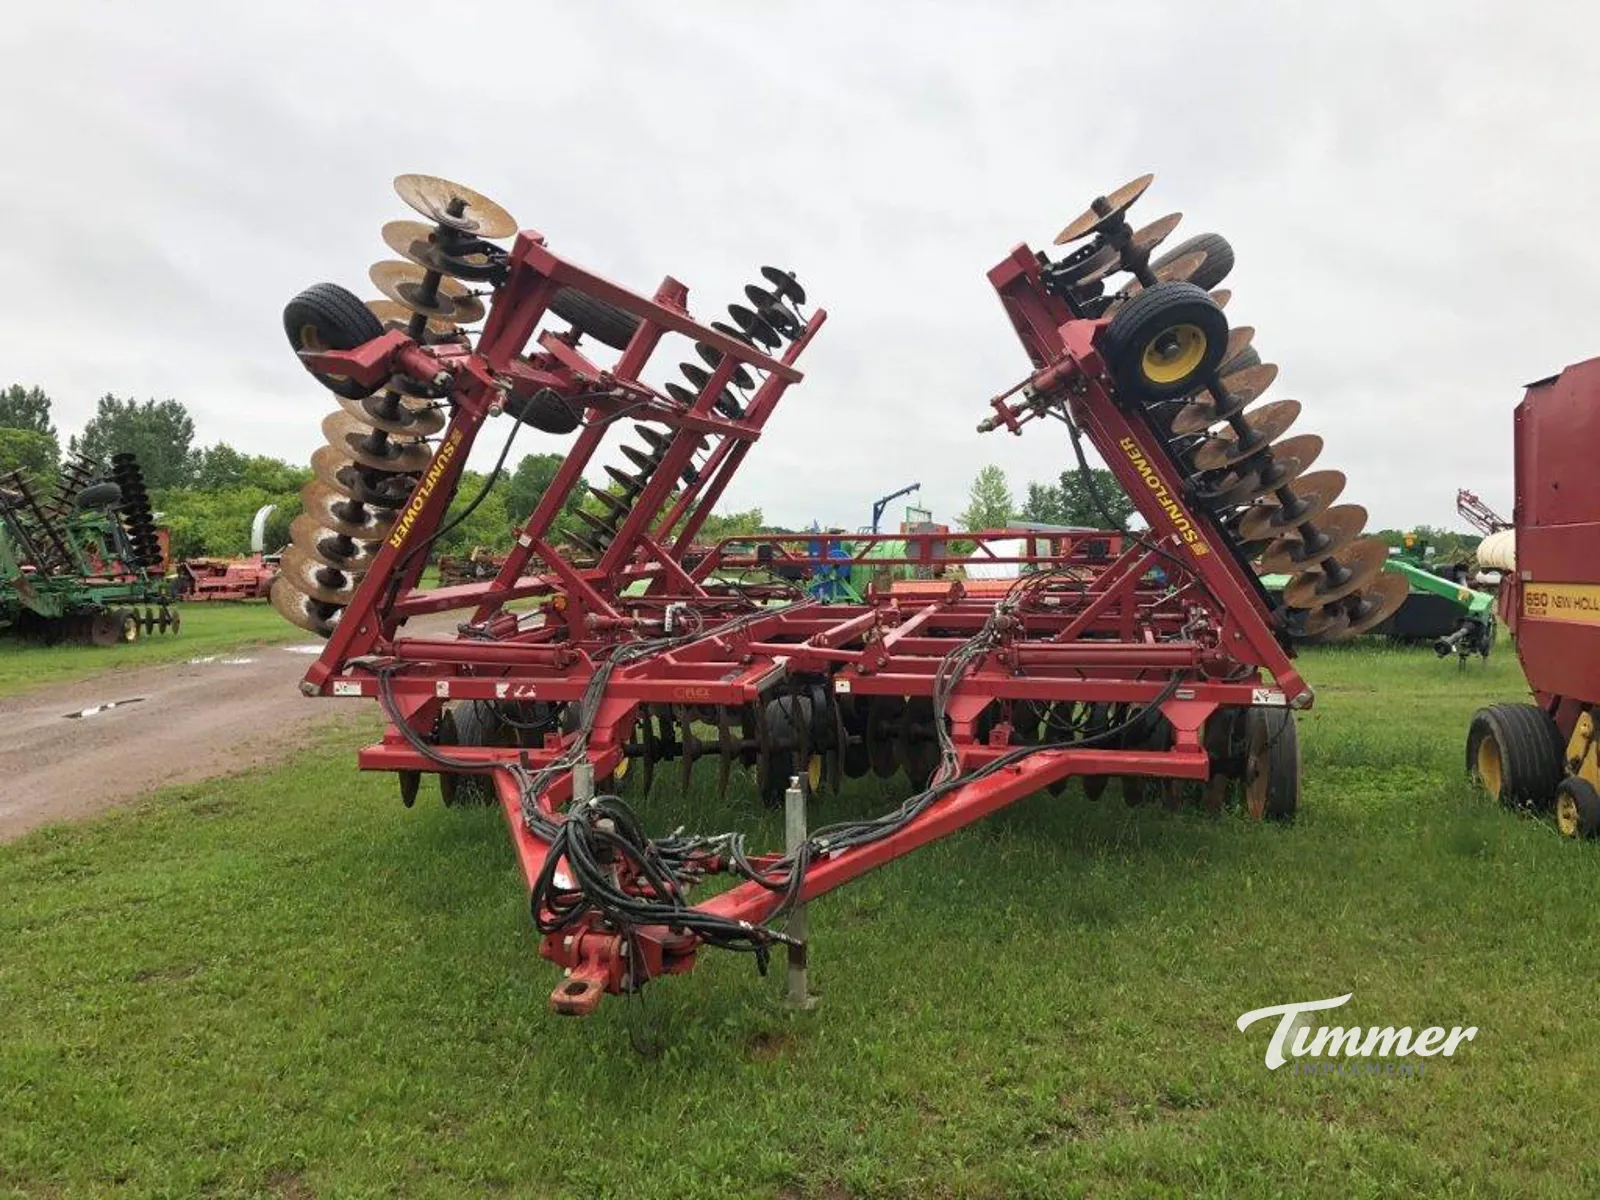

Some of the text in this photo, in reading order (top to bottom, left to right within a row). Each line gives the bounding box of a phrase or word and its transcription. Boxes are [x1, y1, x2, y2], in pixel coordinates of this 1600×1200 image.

[389, 441, 455, 548] SUNFLOWER
[1120, 436, 1198, 544] SUNFLOWER
[1551, 595, 1571, 609] NEW
